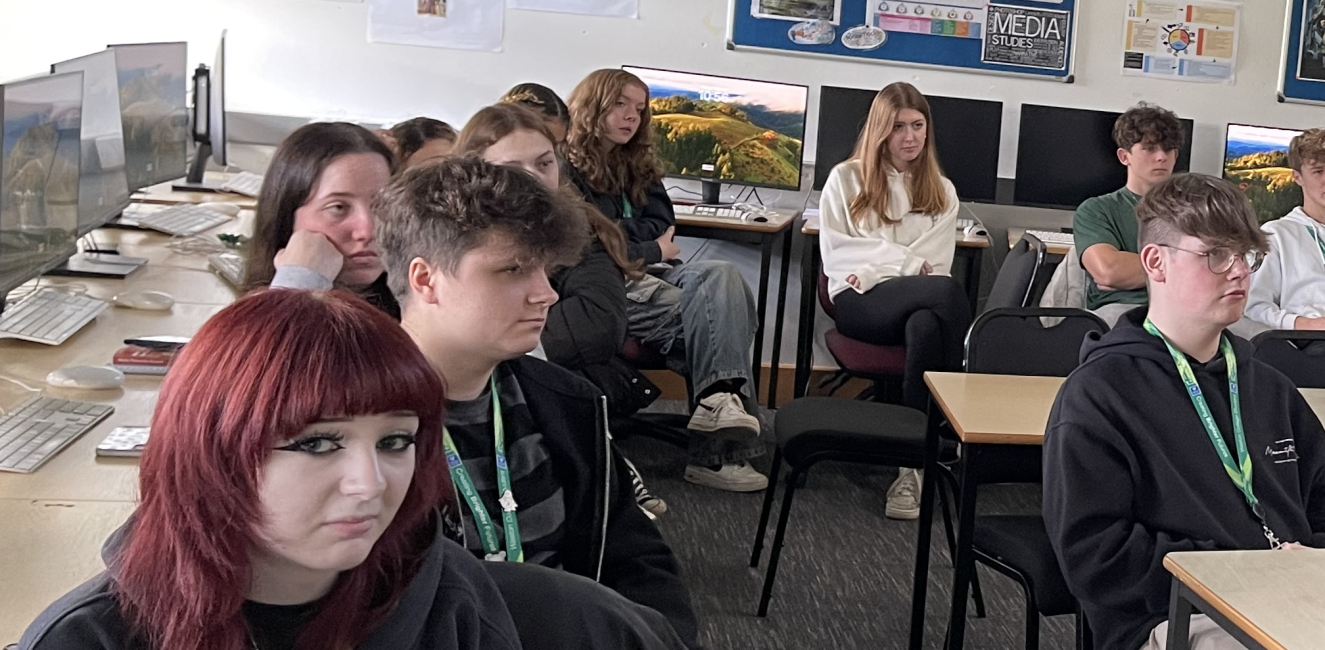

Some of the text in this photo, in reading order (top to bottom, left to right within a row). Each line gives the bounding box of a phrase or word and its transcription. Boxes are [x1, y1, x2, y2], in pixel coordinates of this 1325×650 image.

[993, 12, 1060, 40] MEDIA
[992, 34, 1033, 48] STUDIES
[698, 90, 729, 103] 10:56
[1195, 396, 1229, 457] Creating Brighter Futures
[456, 468, 472, 496] Creating
[471, 496, 487, 524] Brighter
[508, 523, 517, 551] Weston
